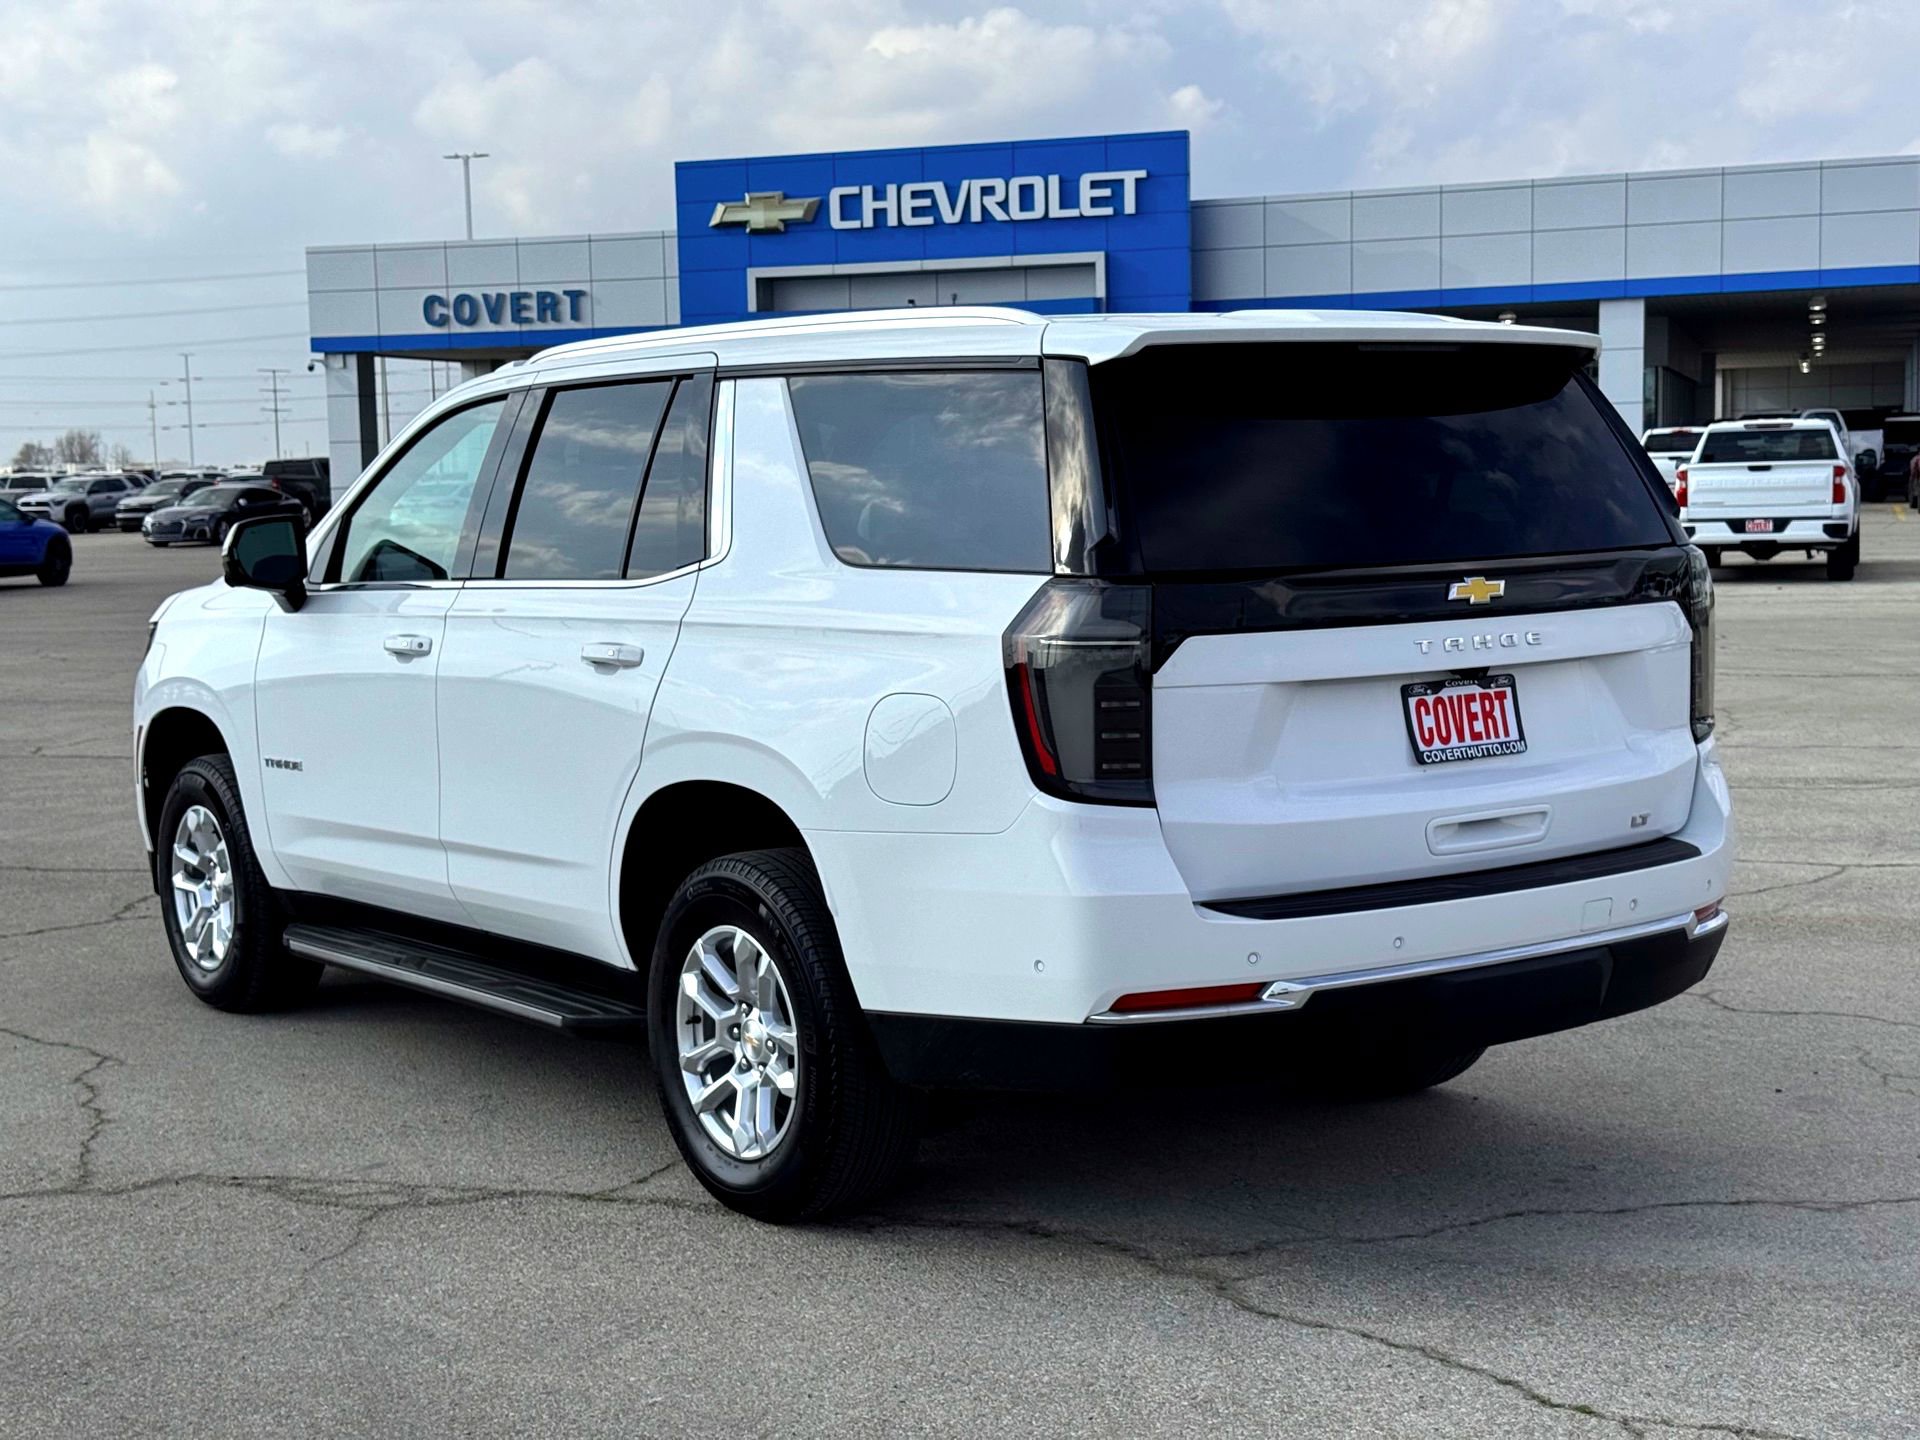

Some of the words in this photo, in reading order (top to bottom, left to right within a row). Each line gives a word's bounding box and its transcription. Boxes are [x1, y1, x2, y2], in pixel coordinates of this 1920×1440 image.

[828, 169, 1147, 230] CHEVROLET
[422, 289, 588, 330] COVERT
[1414, 632, 1543, 654] TAHOE
[1415, 691, 1510, 747] COVERT
[1423, 741, 1526, 763] COVERTHUTTO.COM
[1631, 813, 1650, 828] LT
